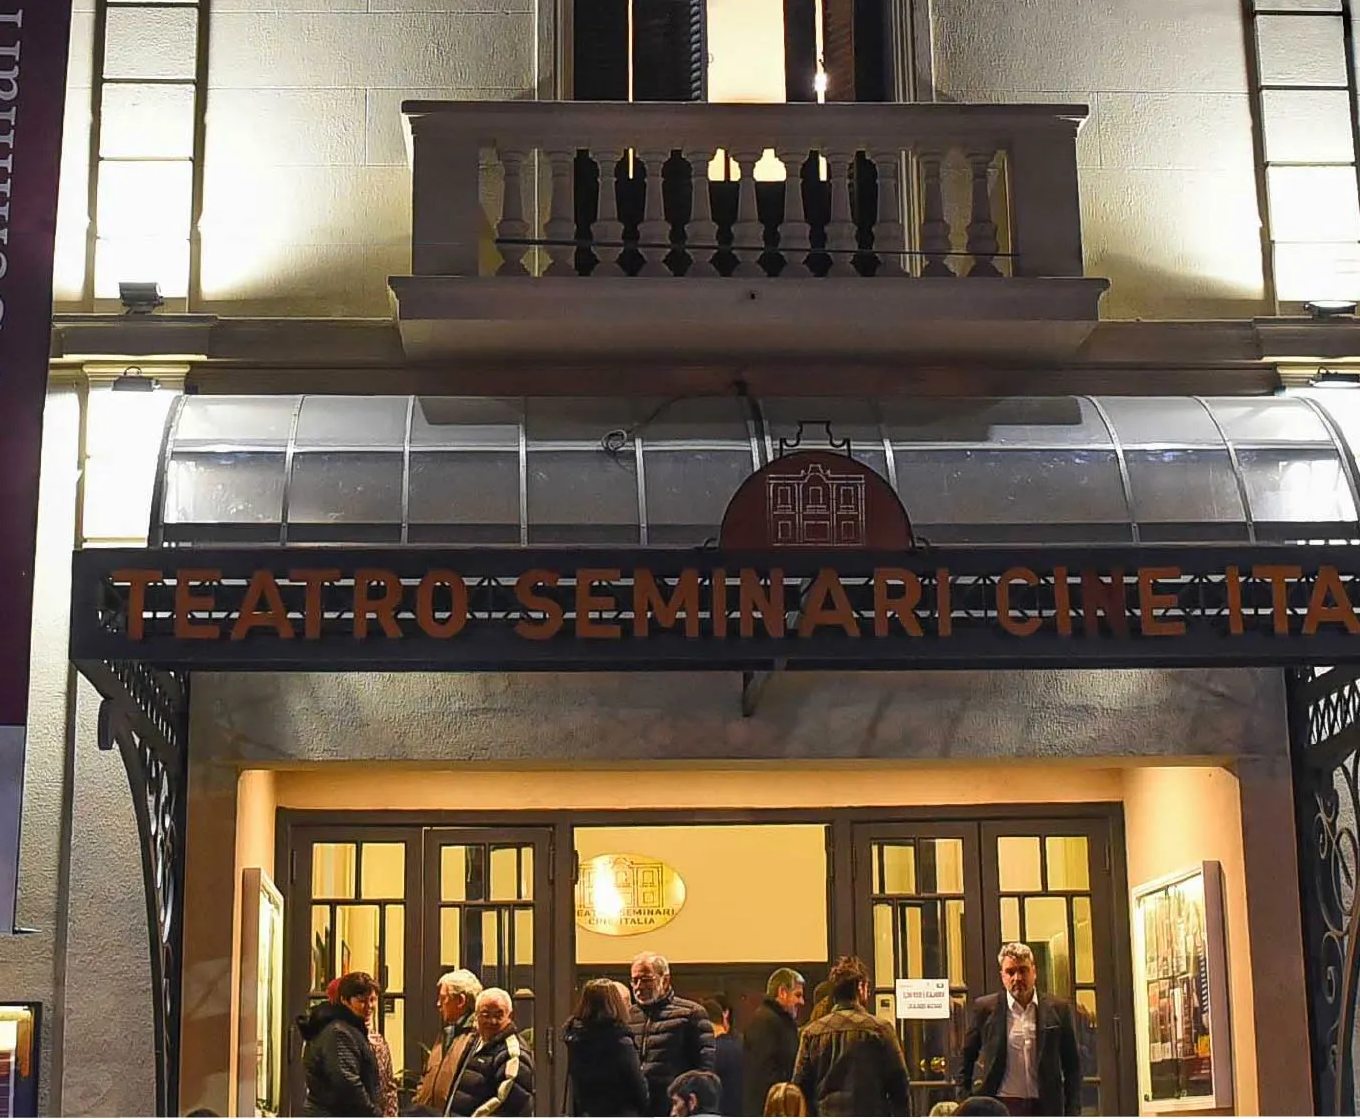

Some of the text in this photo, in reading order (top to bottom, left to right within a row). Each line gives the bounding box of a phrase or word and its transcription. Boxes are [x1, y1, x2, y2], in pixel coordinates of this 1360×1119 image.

[110, 568, 469, 641] TEATRO
[514, 567, 950, 640] SEMINARI
[995, 566, 1187, 638] CINE
